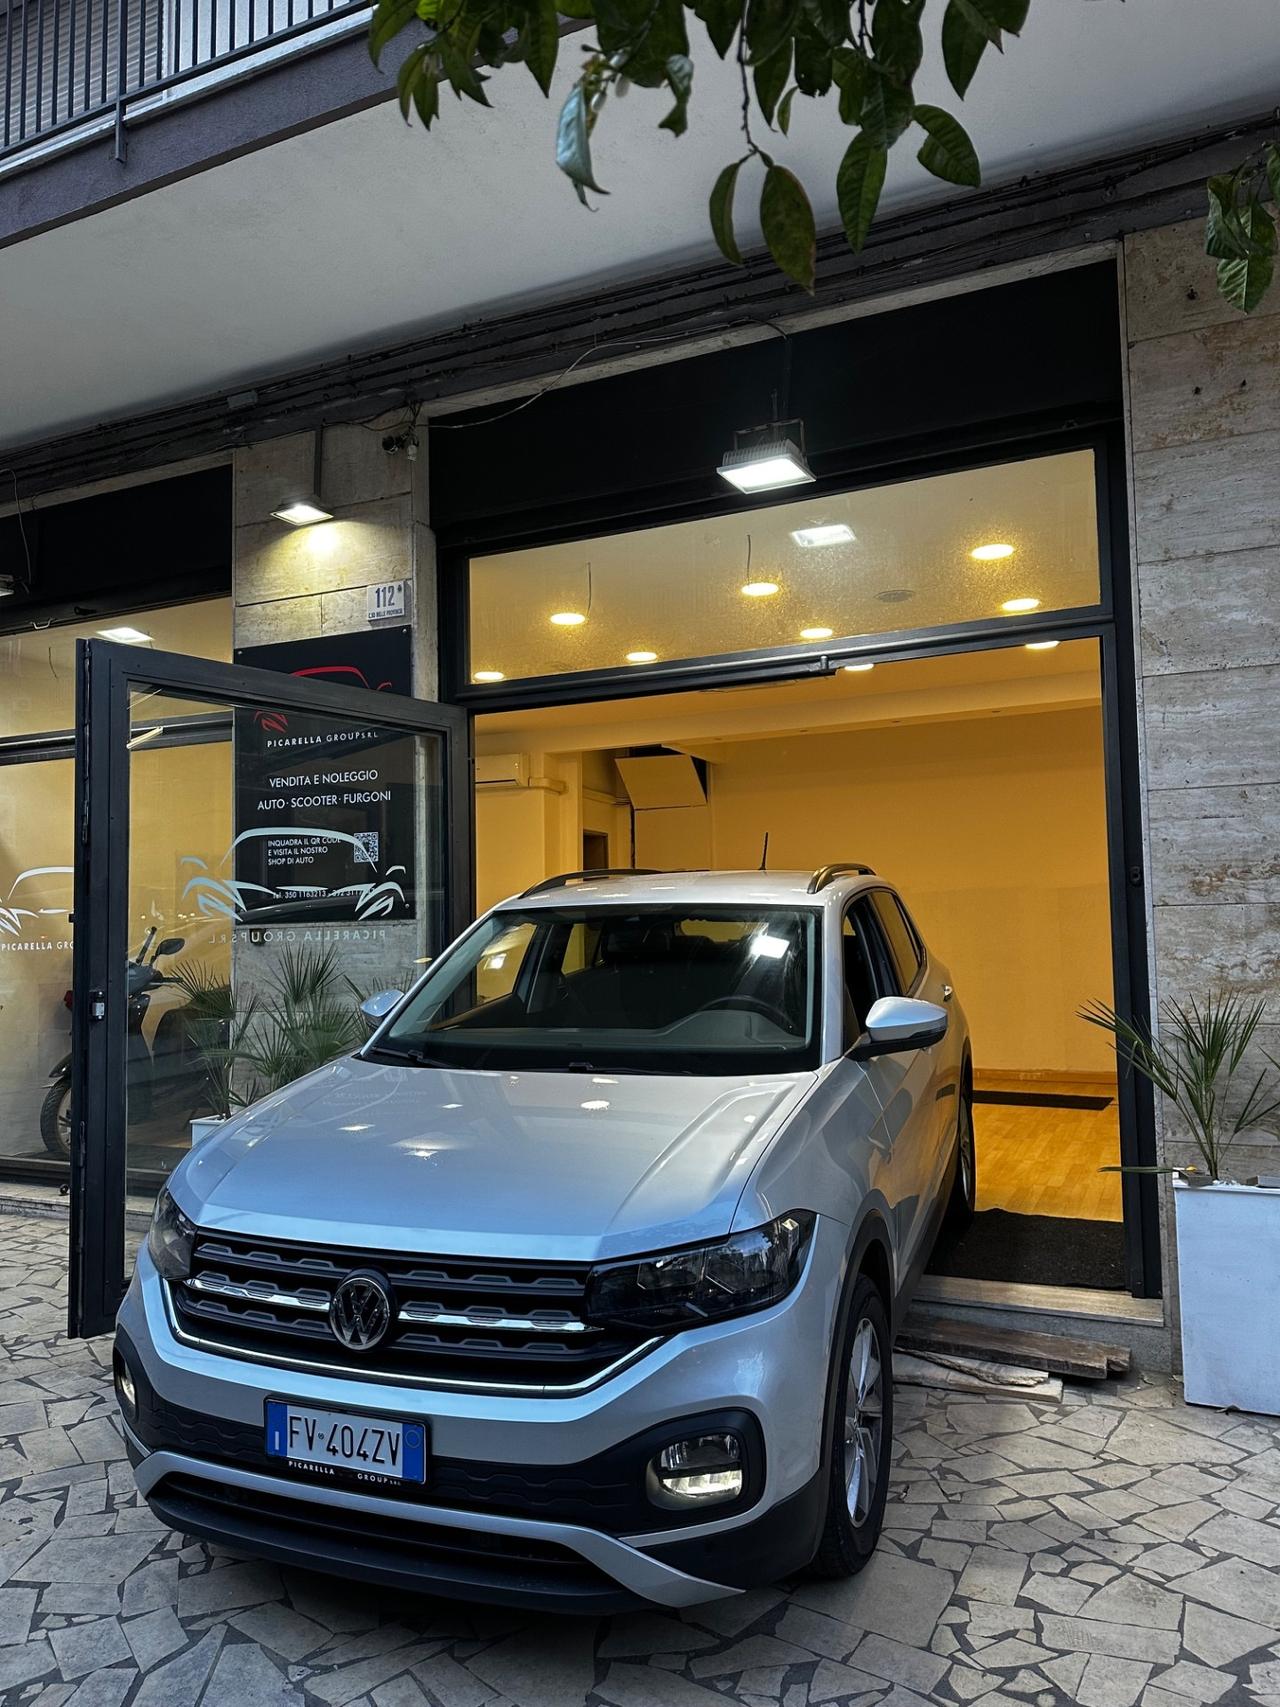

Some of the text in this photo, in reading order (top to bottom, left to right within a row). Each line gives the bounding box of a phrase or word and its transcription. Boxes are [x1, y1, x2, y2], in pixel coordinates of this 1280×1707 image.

[375, 585, 395, 608] 112
[267, 735, 322, 747] PICARELLA
[326, 732, 360, 743] GROUP
[269, 769, 378, 788] VENDITA E NOLEGGIO
[257, 790, 391, 810] AUTO SCOOTER FURGONI
[267, 838, 303, 847] INQUADRA
[310, 837, 321, 845] QR
[273, 848, 293, 856] VISITA
[300, 846, 329, 854] NOSTRO
[295, 856, 314, 864] AUTO
[1, 942, 53, 951] PICARELLA
[288, 1460, 335, 1475] PICARELLA
[357, 1472, 388, 1484] GROUP
